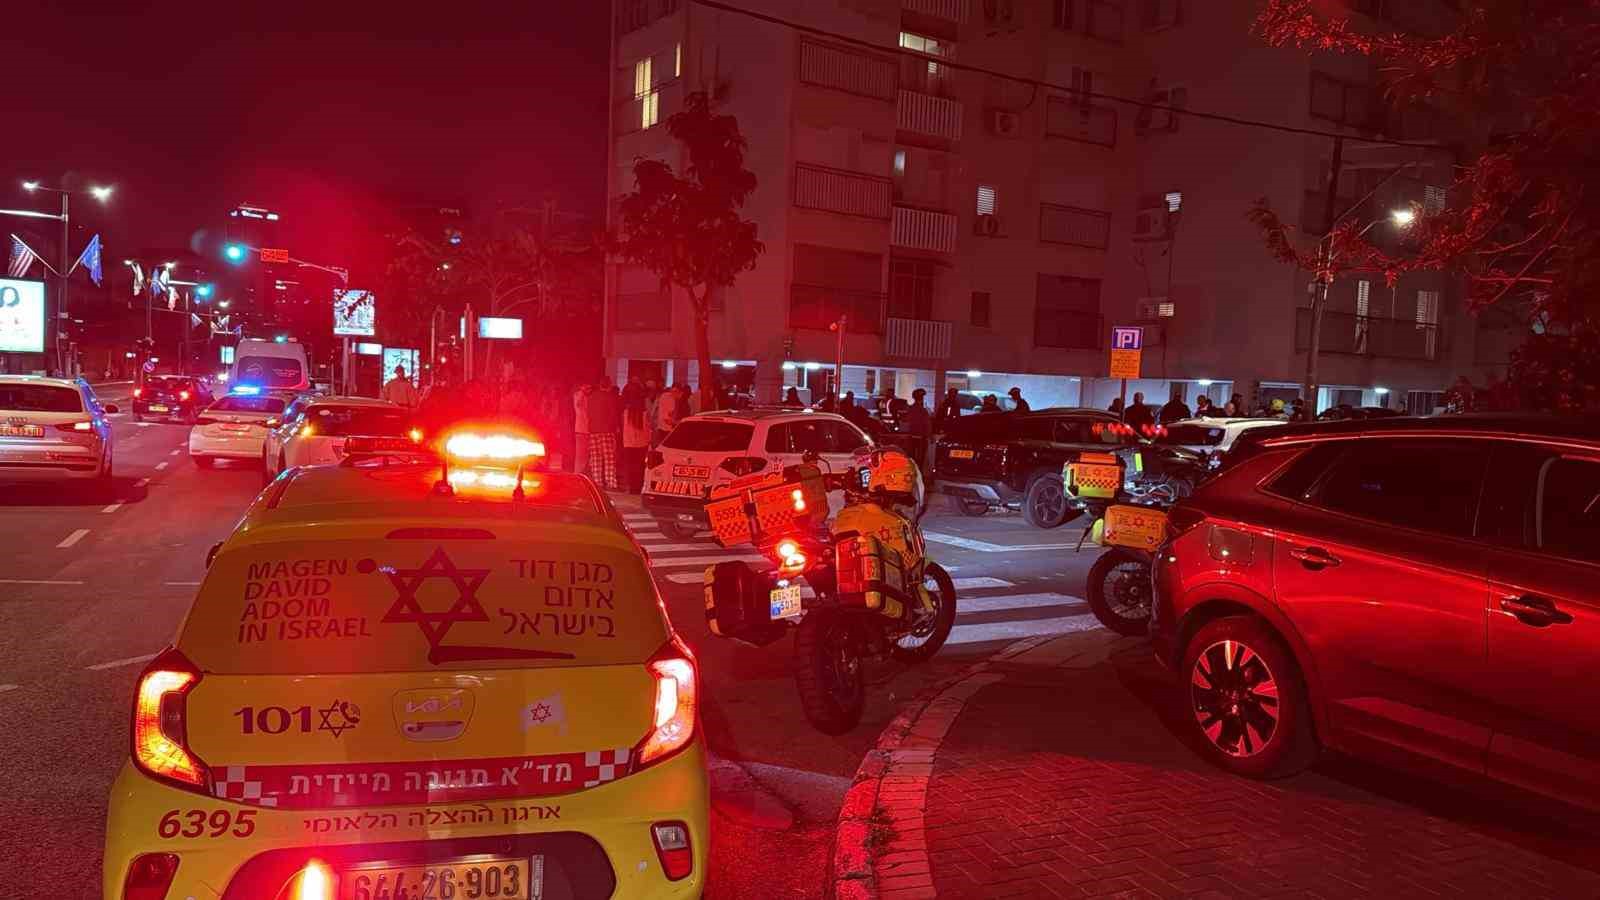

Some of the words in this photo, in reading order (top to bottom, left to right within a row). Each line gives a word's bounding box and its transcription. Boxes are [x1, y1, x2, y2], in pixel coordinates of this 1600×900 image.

[247, 558, 348, 580] MAGEN
[509, 559, 556, 580] דוד
[569, 560, 613, 584] מגן
[244, 578, 333, 600] DAVID
[544, 585, 614, 609] אדום
[240, 598, 330, 621] ADOM
[238, 622, 268, 643] IN
[278, 617, 372, 640] ISRAEL
[499, 607, 615, 638] בישראל
[233, 706, 312, 734] 101
[288, 772, 391, 794] מיידית
[403, 767, 489, 791] תגובה
[158, 809, 258, 838] 6395
[303, 811, 397, 833] הלאומי
[408, 806, 494, 826] ההצלה
[502, 804, 561, 825] ארגון
